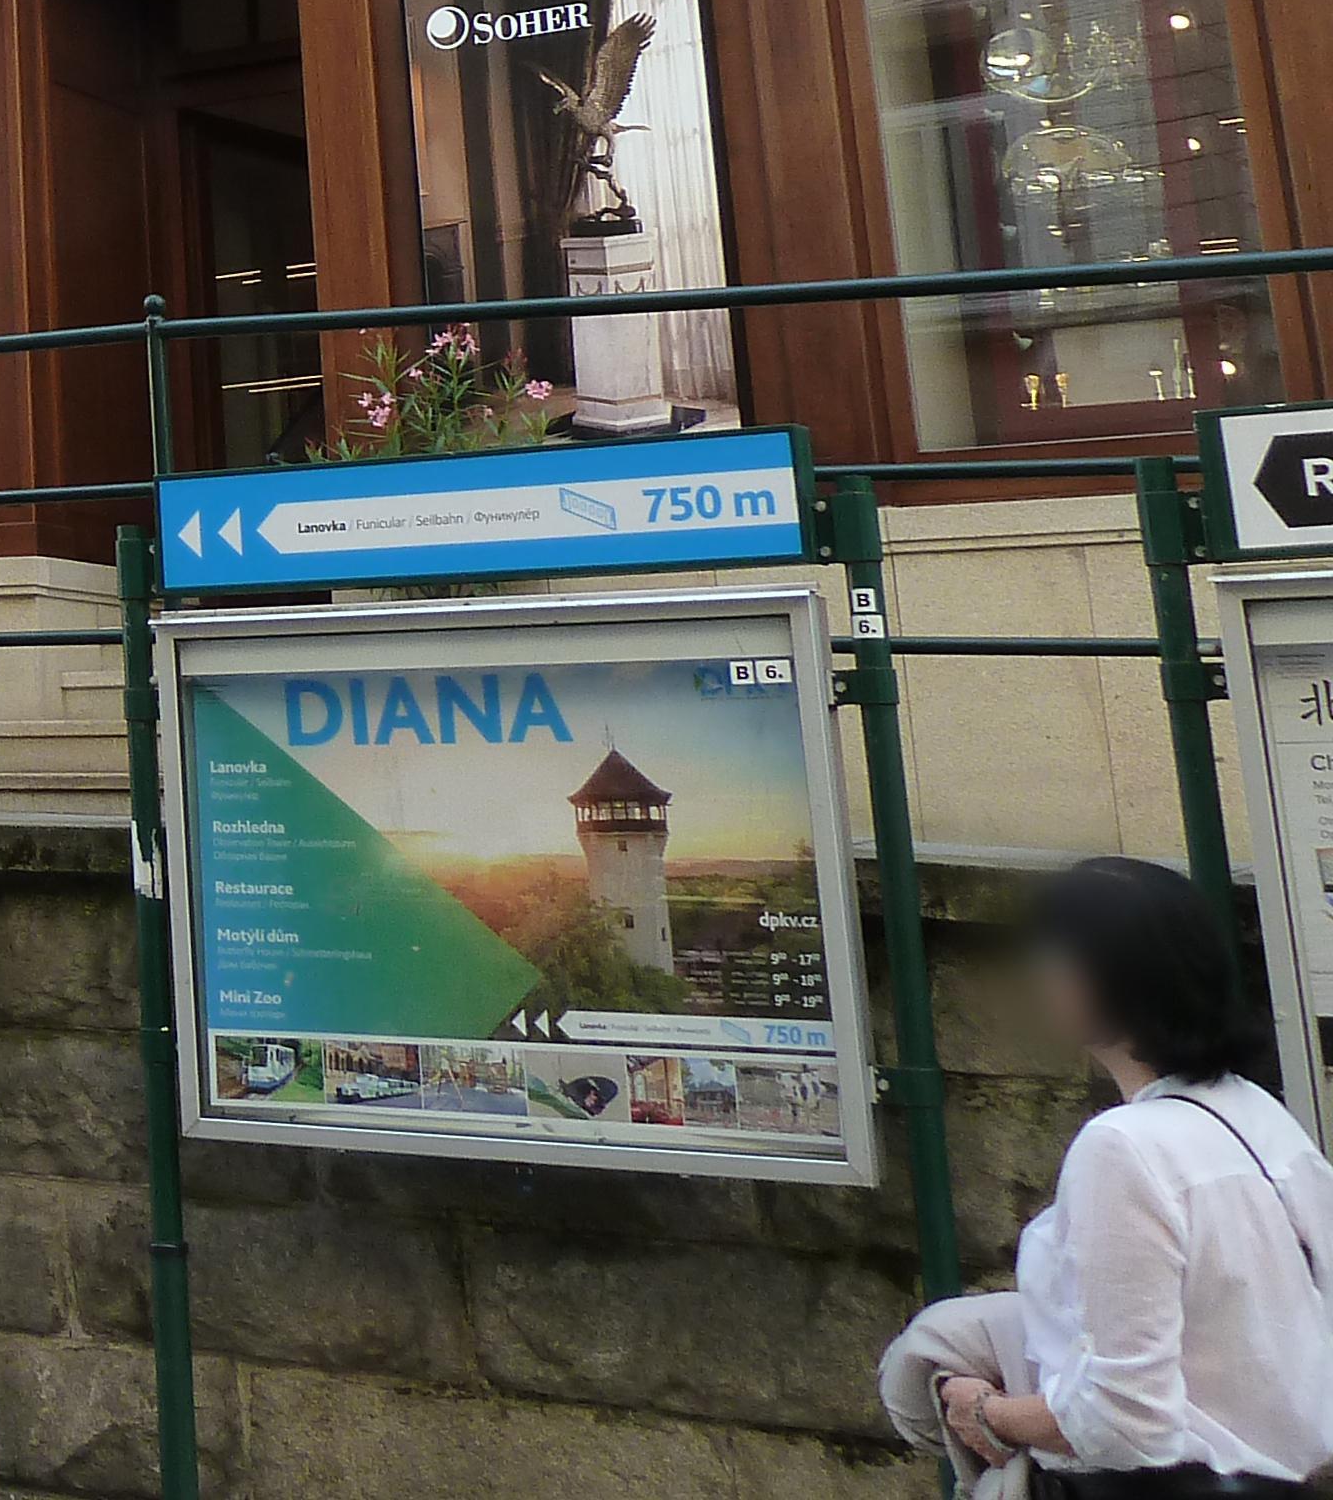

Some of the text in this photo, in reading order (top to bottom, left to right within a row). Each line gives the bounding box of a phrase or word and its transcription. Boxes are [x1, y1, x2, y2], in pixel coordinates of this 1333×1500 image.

[473, 2, 592, 46] SOHER
[298, 486, 775, 534] Lanovka Funicular Seilbahn 750 m
[473, 508, 540, 523] Фуникулёр
[857, 594, 870, 607] B
[859, 620, 877, 634] 6.
[737, 666, 749, 680] B
[766, 665, 783, 679] 6.
[284, 674, 573, 746] DIANA
[210, 761, 267, 773] Lanovka
[213, 820, 285, 834] Rozhledna
[215, 881, 293, 895] Restaurace
[759, 912, 818, 931] dpkv.cz
[267, 929, 299, 943] dům
[220, 990, 282, 1005] Mini Zoo
[764, 1025, 826, 1046] 750 m
